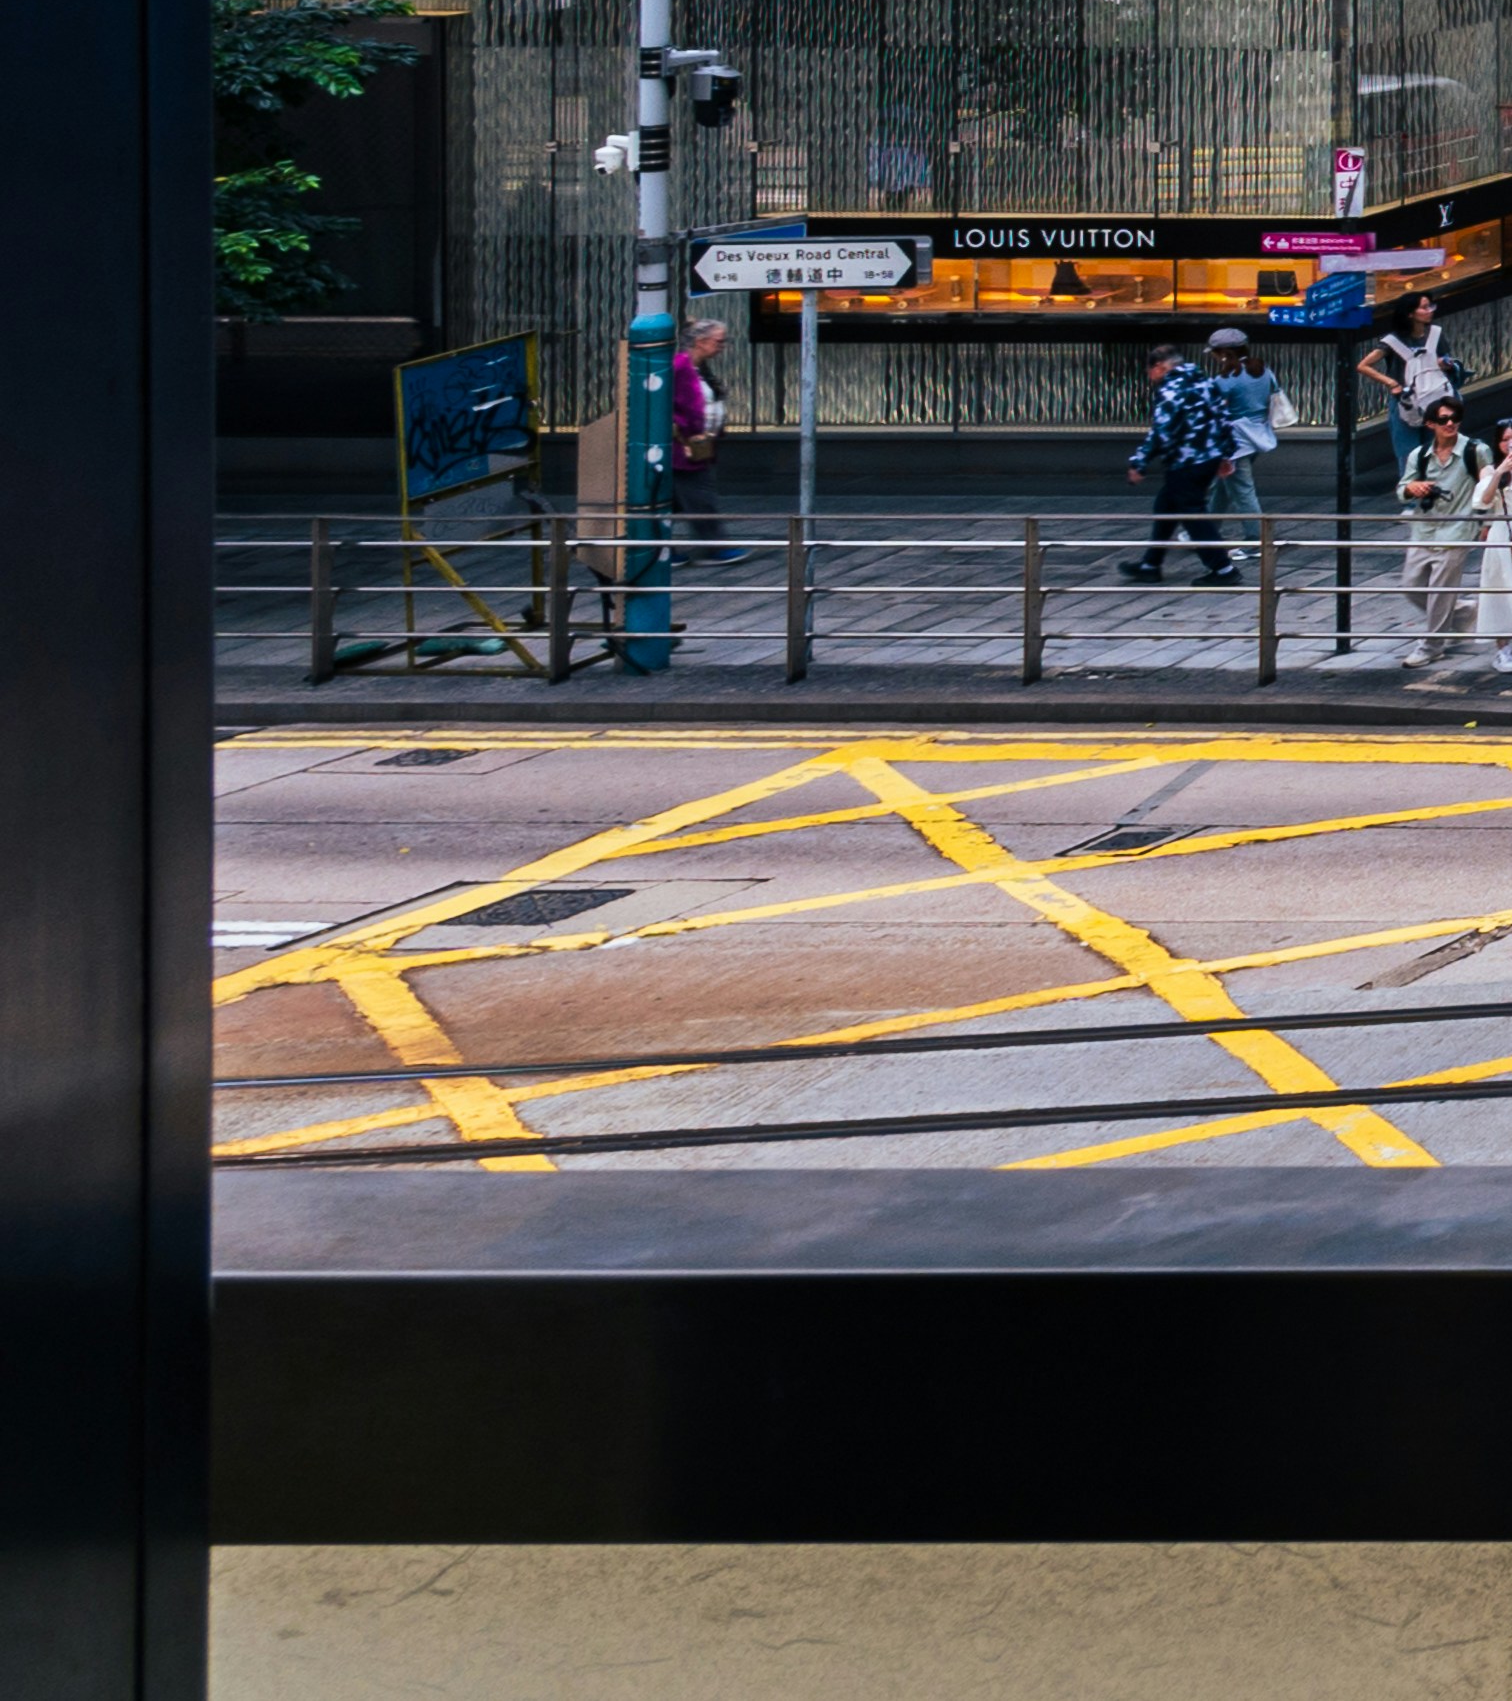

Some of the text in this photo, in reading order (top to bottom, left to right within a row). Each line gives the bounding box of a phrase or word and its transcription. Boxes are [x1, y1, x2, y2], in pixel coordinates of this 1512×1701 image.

[954, 228, 1155, 248] LOUIS VUITTON
[716, 247, 891, 262] Des Voeux Road Central
[766, 268, 844, 284] 德輔道中
